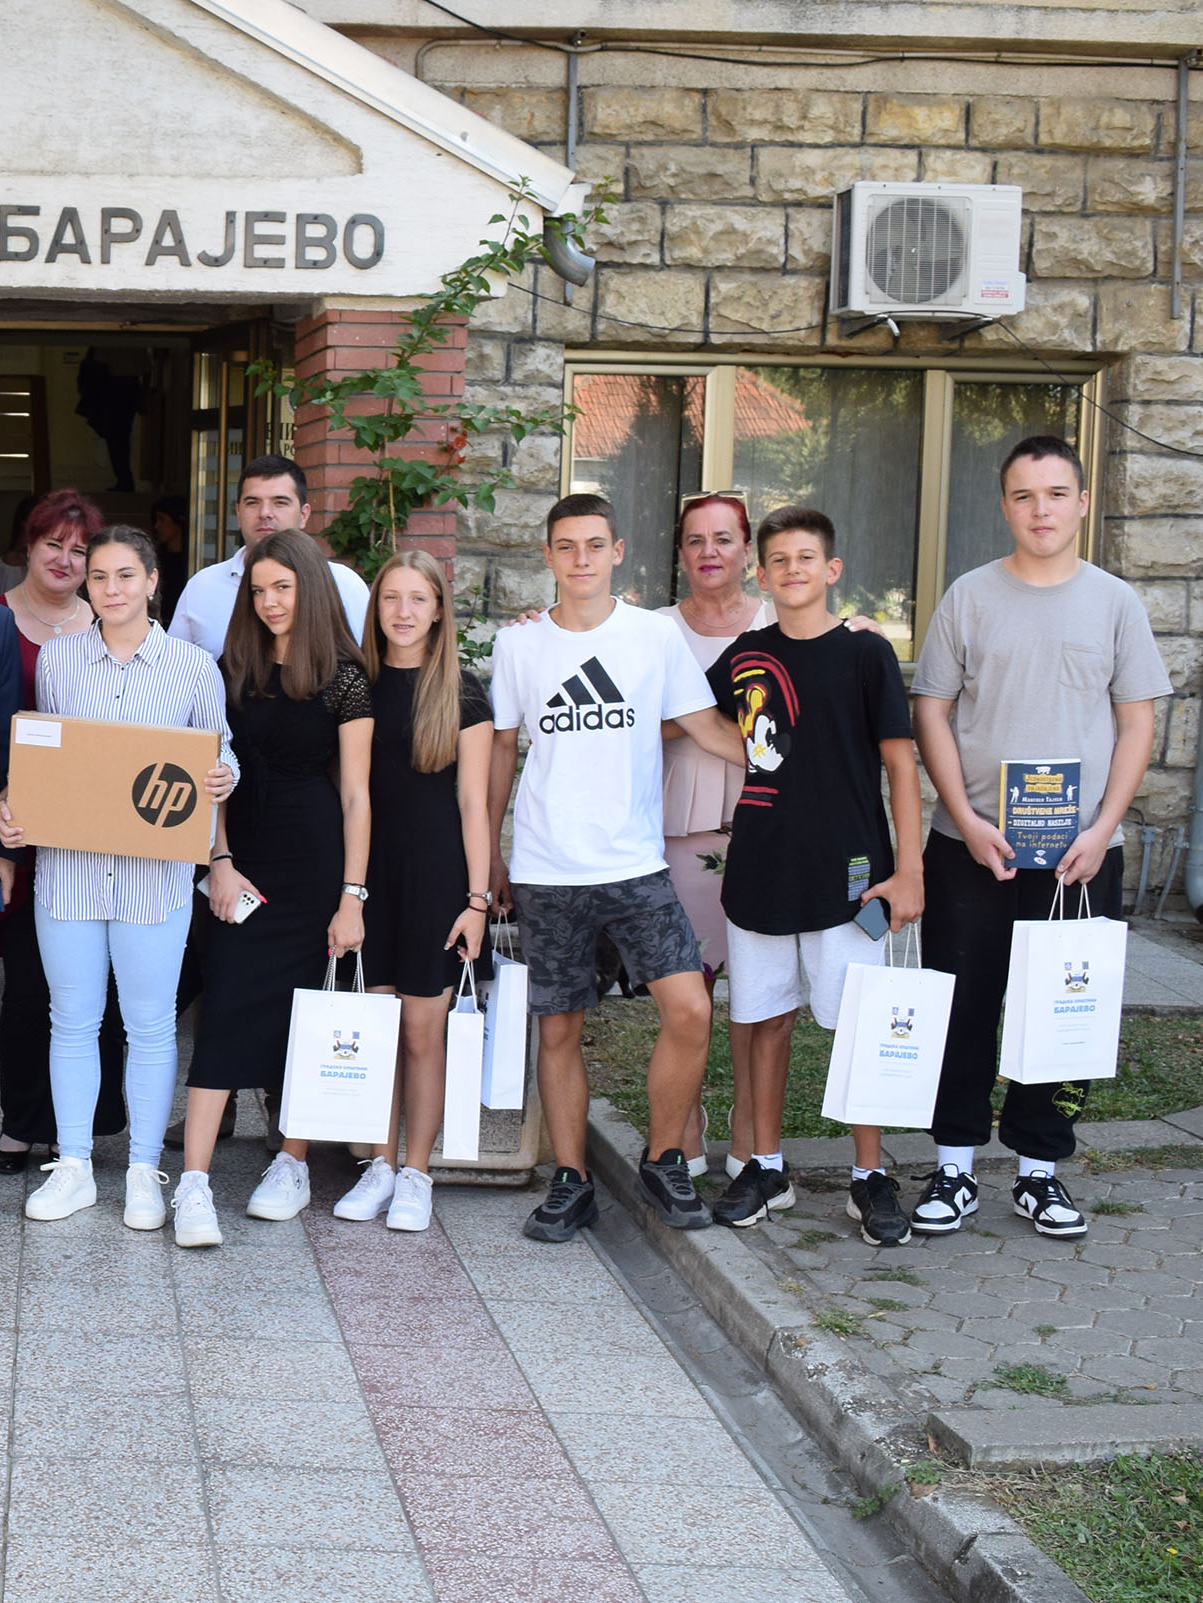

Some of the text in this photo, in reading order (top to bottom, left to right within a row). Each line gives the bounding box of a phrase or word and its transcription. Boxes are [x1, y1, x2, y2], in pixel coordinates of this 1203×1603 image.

[539, 704, 635, 734] adidas
[138, 762, 192, 828] hp
[1017, 831, 1068, 841] Tvoji podaci
[1054, 1005, 1095, 1014] БАРАЈЕВО
[879, 1050, 918, 1059] БАРАЈЕВО
[320, 1070, 366, 1079] БАРАЈЕВО
